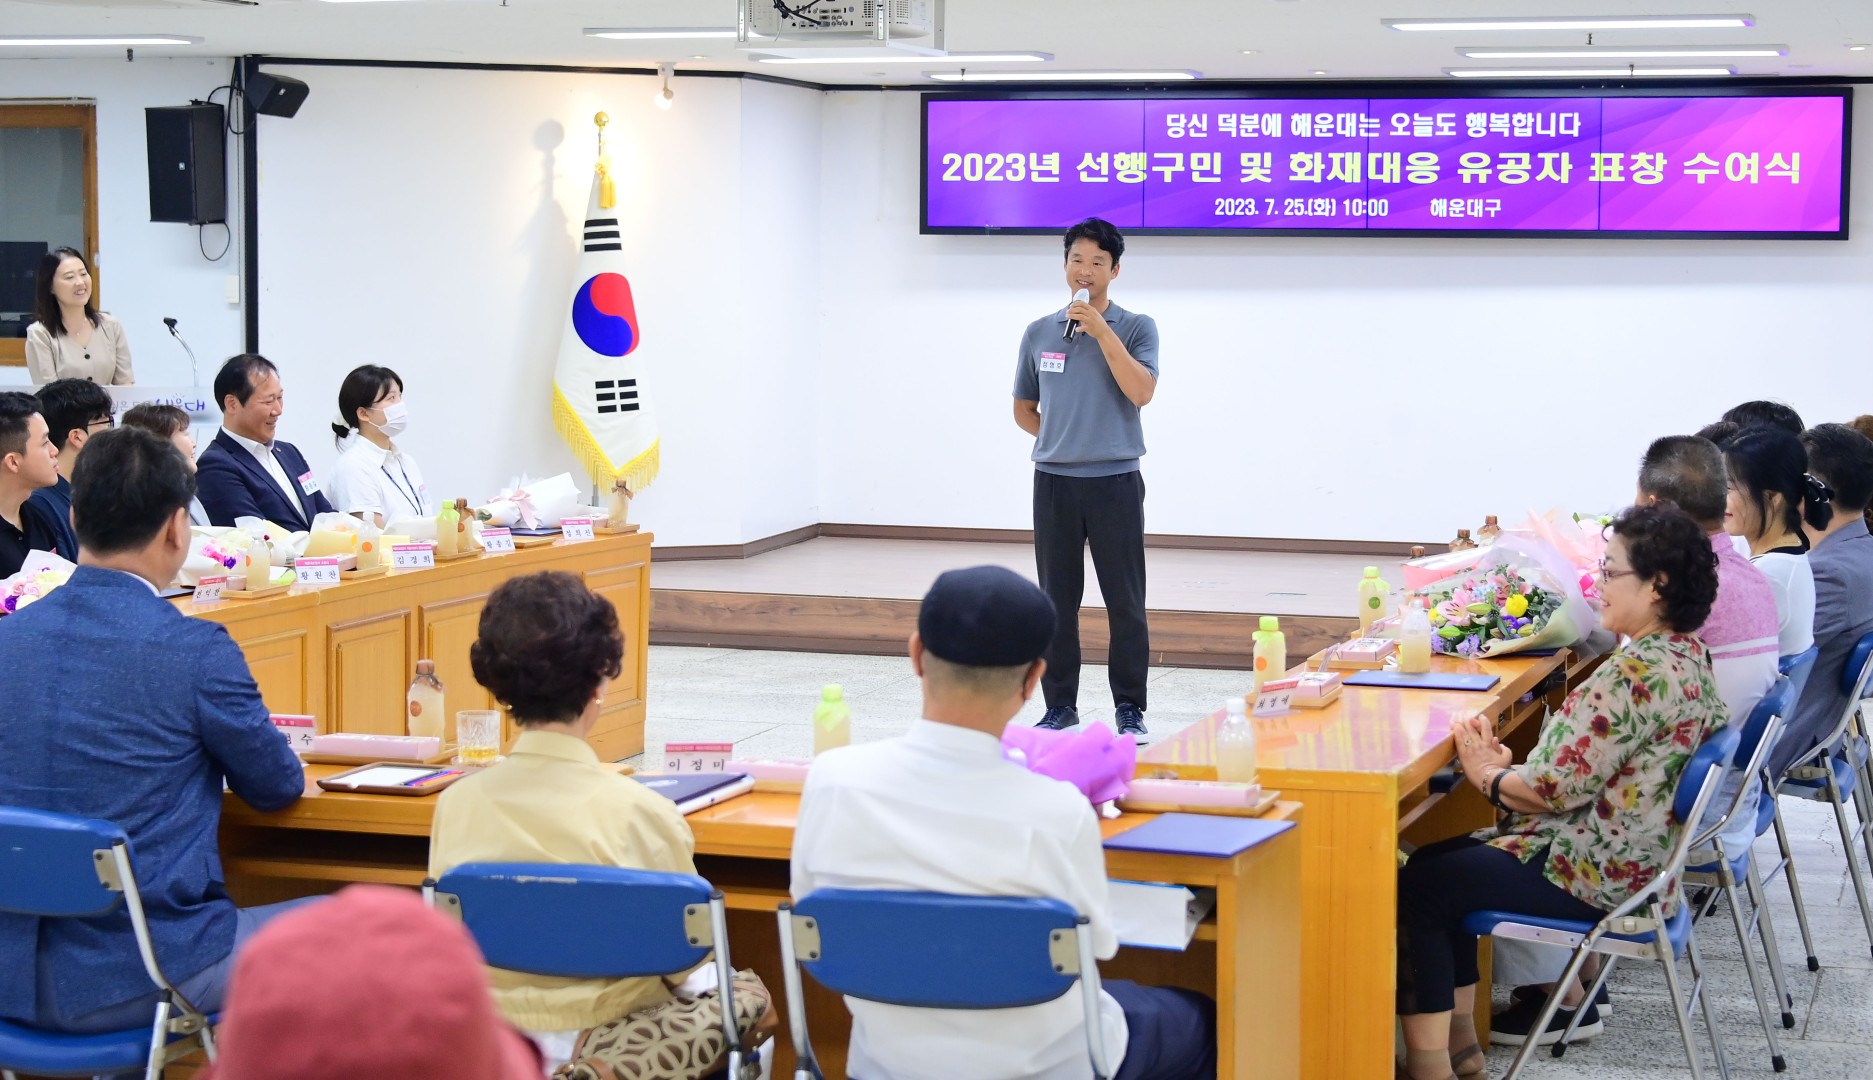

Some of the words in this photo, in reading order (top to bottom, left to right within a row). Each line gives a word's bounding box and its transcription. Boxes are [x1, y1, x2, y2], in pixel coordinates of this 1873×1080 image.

[1167, 114, 1207, 138] 당신
[1218, 114, 1281, 137] 덕분에
[1291, 113, 1380, 137] 해운대는
[1390, 113, 1456, 136] 오늘도
[1466, 113, 1581, 137] 행복합니다
[943, 153, 1059, 182] 2023년
[1077, 152, 1221, 183] 선행구민
[1240, 152, 1271, 182] 및
[1289, 152, 1440, 183] 화재대응
[1458, 152, 1572, 184] 유공자
[1589, 152, 1667, 184] 표창
[1684, 152, 1800, 183] 수여식
[1215, 199, 1258, 215] 2023.
[1265, 199, 1278, 215] 7.
[1284, 198, 1336, 216] 25.(화)
[1343, 199, 1388, 216] 10:00
[1431, 199, 1501, 217] 해운대구
